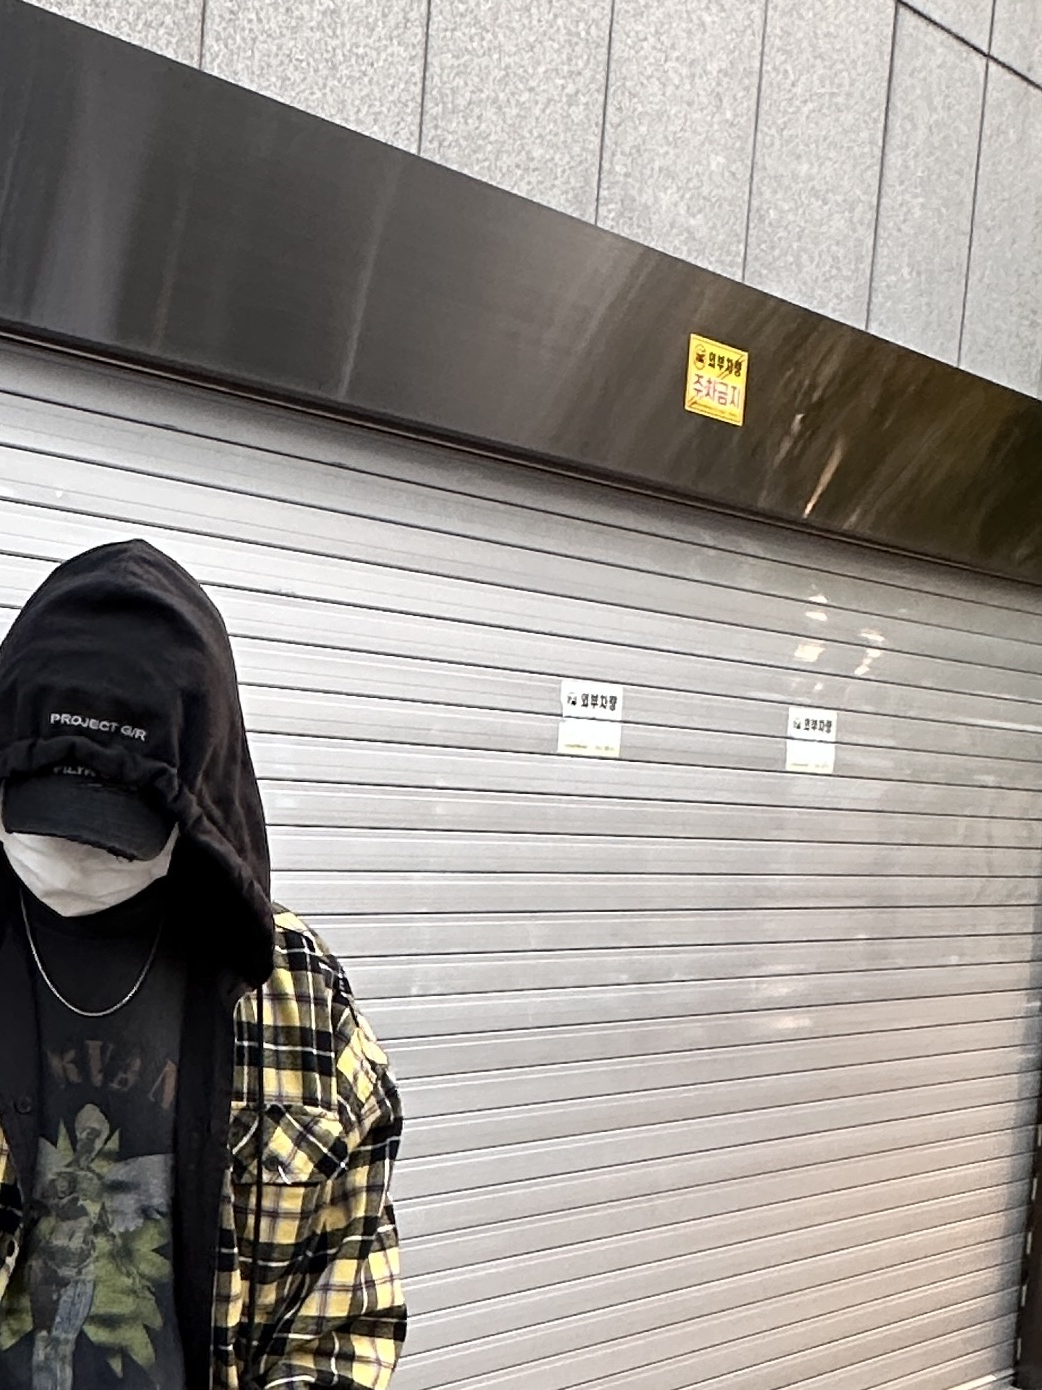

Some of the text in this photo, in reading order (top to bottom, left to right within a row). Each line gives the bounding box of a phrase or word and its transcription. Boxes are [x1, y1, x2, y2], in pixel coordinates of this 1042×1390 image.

[693, 373, 741, 409] 주차금지
[581, 693, 618, 711] 외부차량
[50, 713, 118, 732] PROJECT
